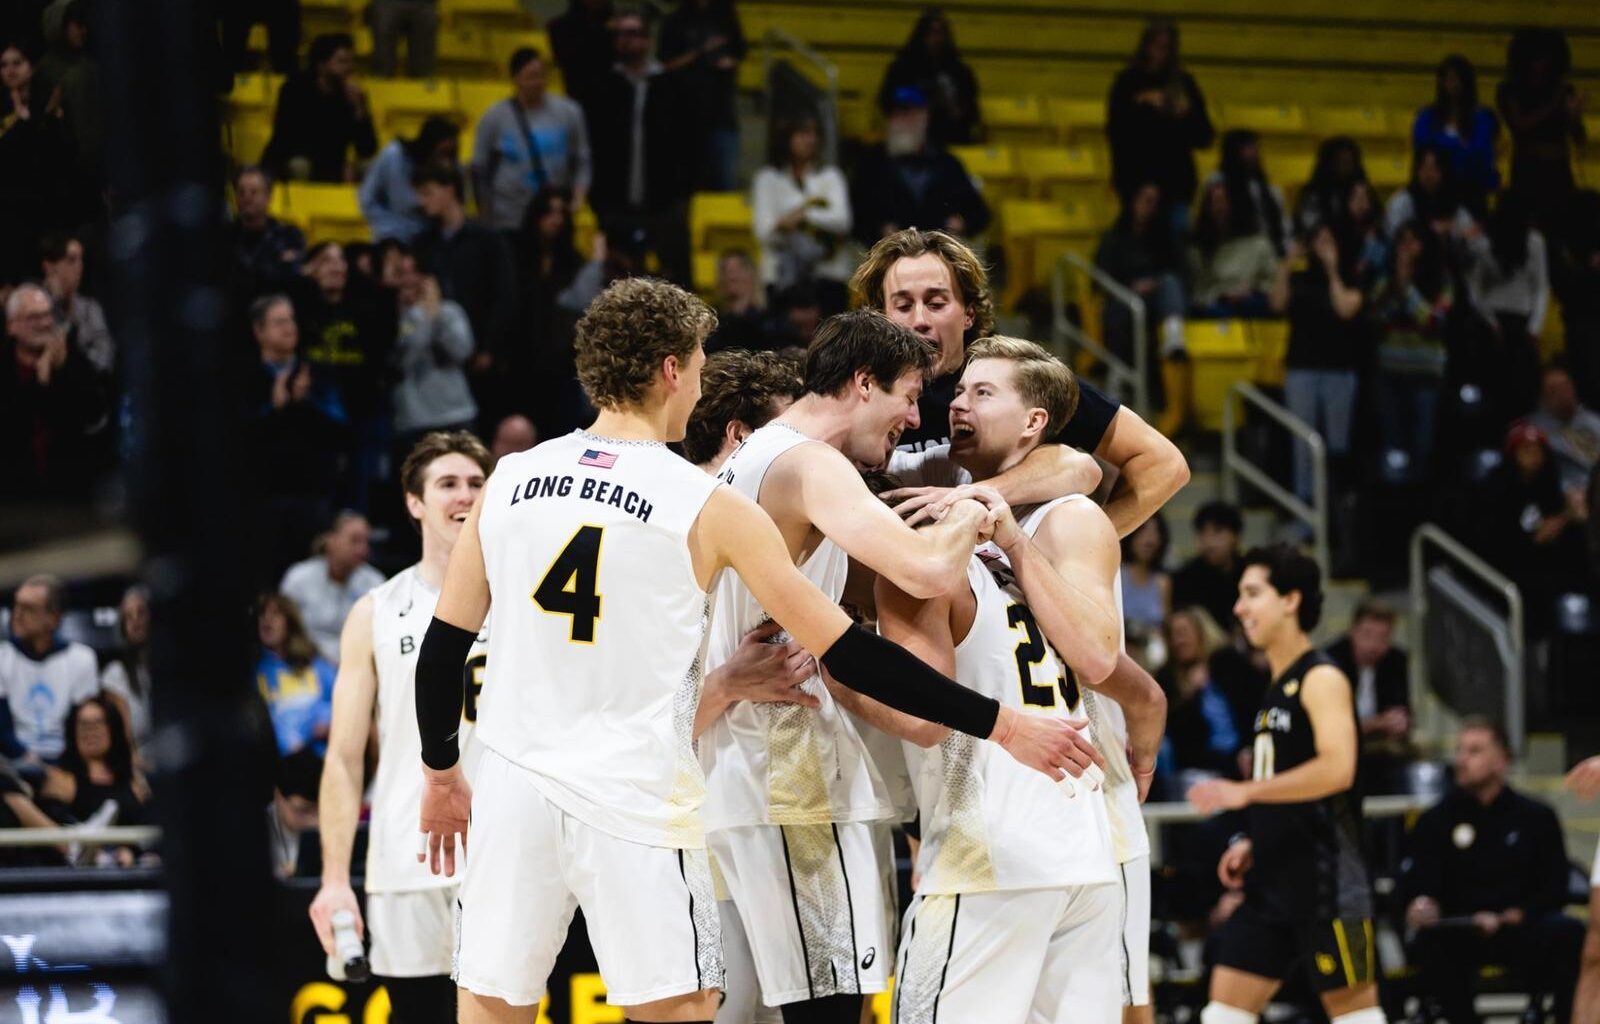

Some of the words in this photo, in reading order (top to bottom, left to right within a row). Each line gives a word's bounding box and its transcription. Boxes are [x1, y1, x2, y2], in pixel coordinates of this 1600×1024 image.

[510, 476, 574, 506] LONG
[580, 478, 654, 523] BEACH
[531, 523, 606, 645] 4
